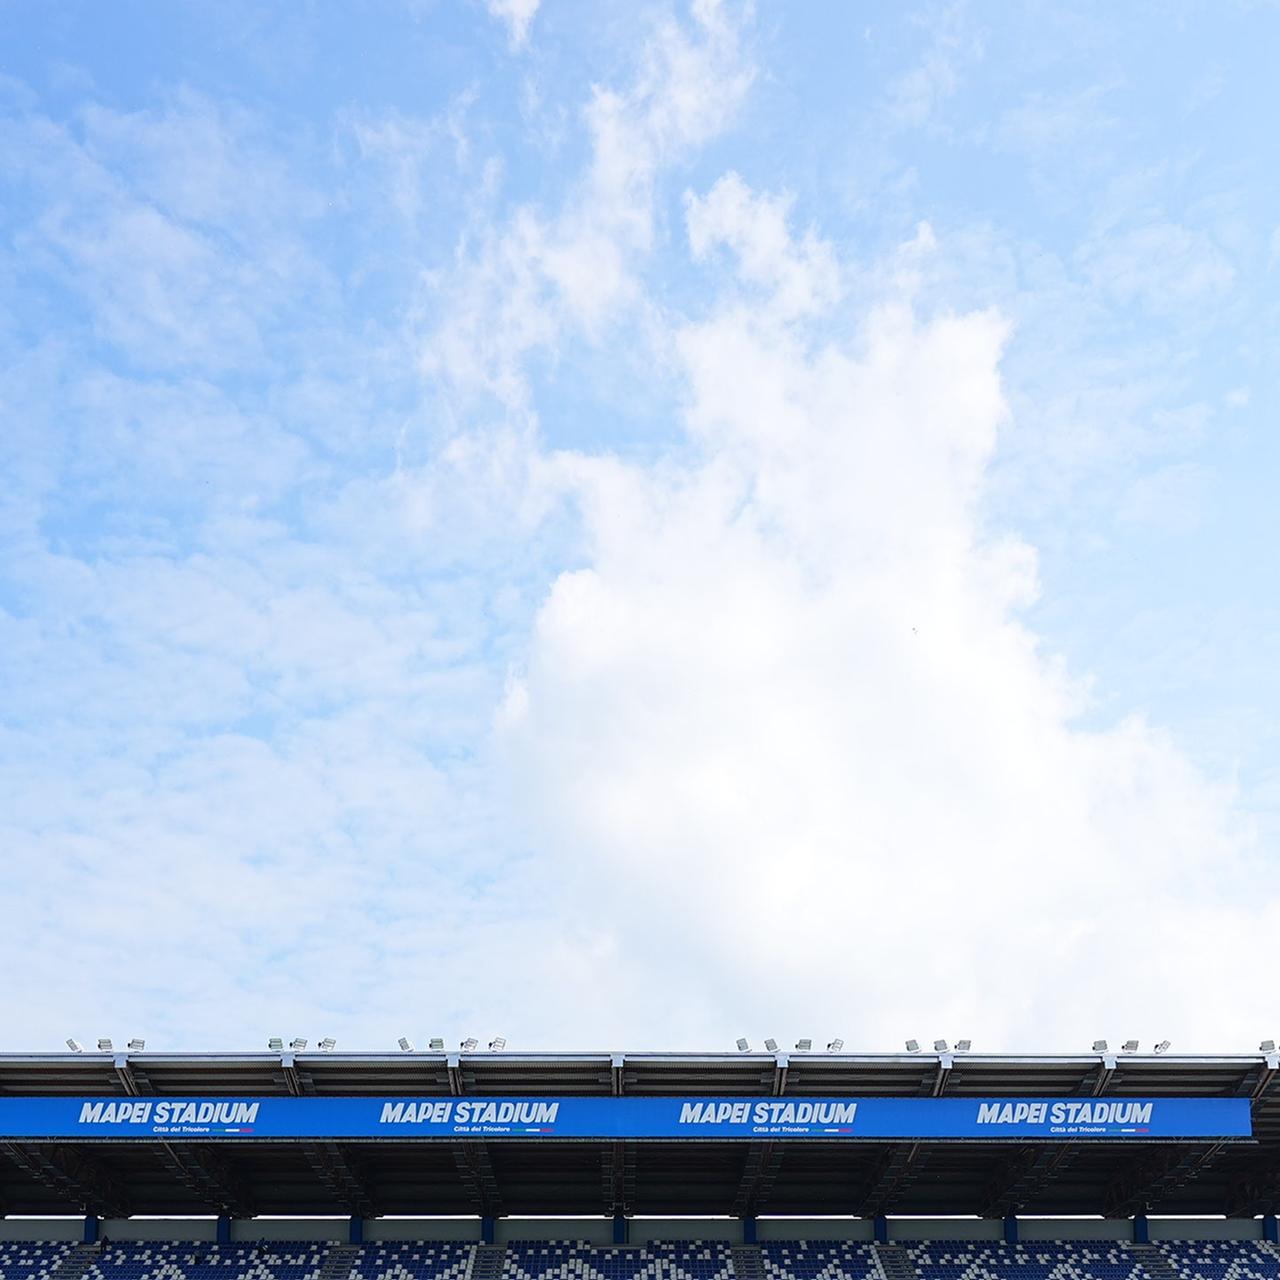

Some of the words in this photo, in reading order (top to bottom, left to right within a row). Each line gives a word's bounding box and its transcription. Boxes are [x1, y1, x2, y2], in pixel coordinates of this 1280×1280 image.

[79, 1102, 152, 1123] MAPEI
[153, 1102, 260, 1123] STADIUM
[380, 1102, 452, 1123] MAPEI
[454, 1102, 559, 1123] STADIUM
[679, 1102, 751, 1124] MAPEI
[753, 1102, 857, 1124] STADIUM
[976, 1103, 1048, 1124] MAPEI
[1050, 1103, 1153, 1124] STADIUM
